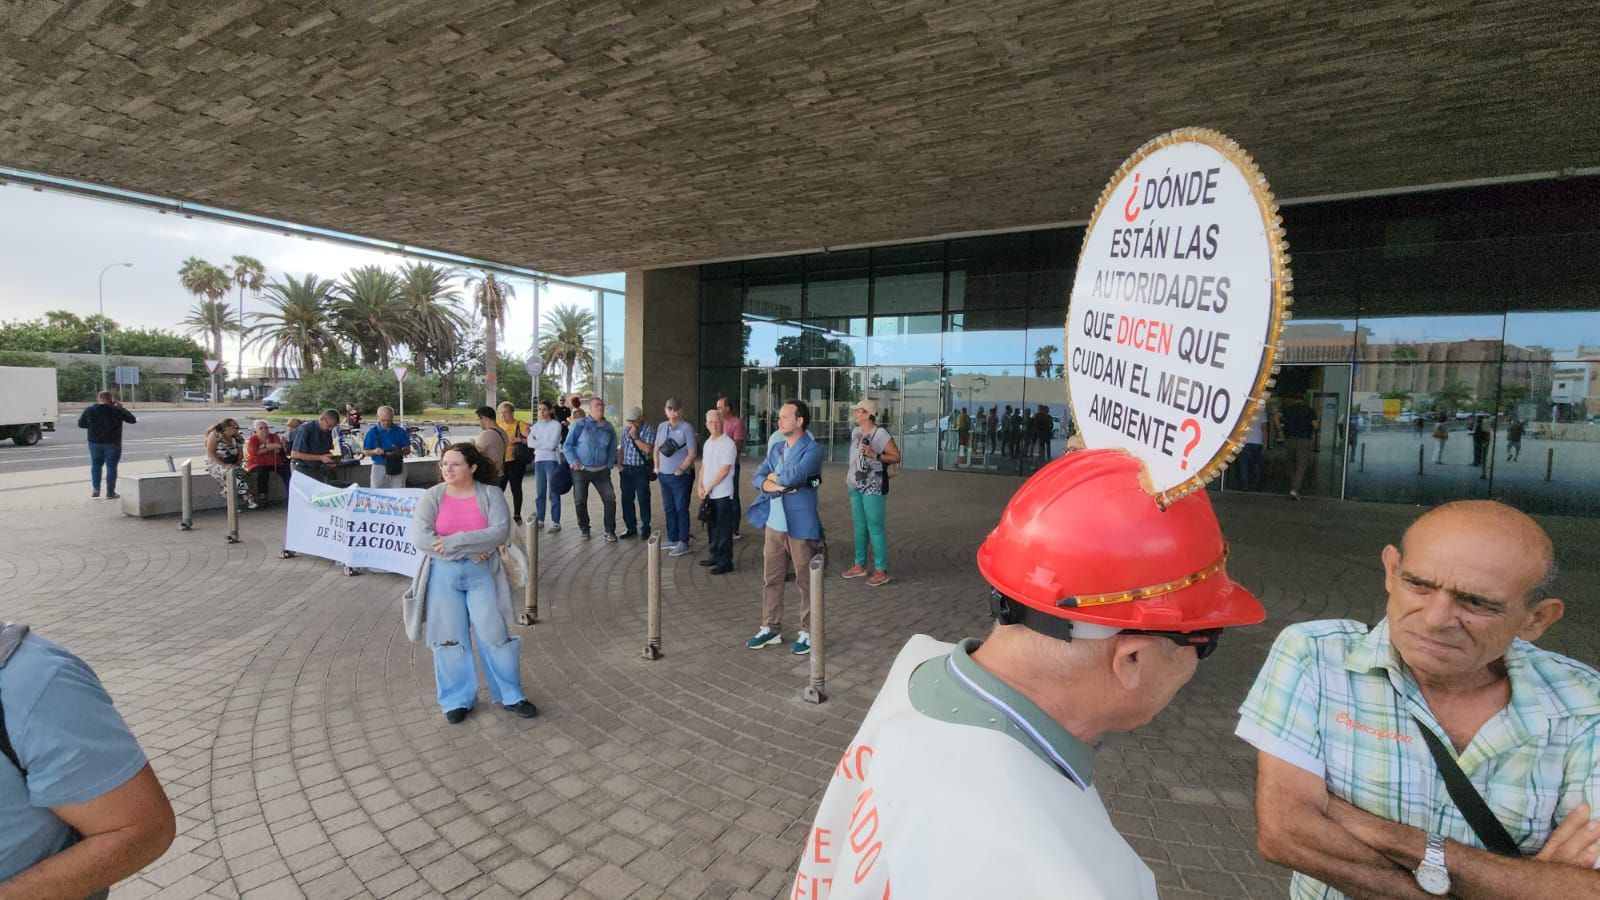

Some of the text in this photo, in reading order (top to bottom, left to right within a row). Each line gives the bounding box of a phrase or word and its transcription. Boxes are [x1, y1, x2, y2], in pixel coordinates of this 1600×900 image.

[1124, 167, 1220, 222] ¿DÓNDE
[1110, 220, 1220, 260] ESTÁN LAS
[1092, 270, 1231, 314] AUTORIDADES
[1083, 309, 1230, 369] QUE DICEN QUE
[1072, 346, 1231, 425] CUIDAN EL MEDIO
[1088, 393, 1202, 471] AMBIENTE?
[316, 526, 330, 538] DE
